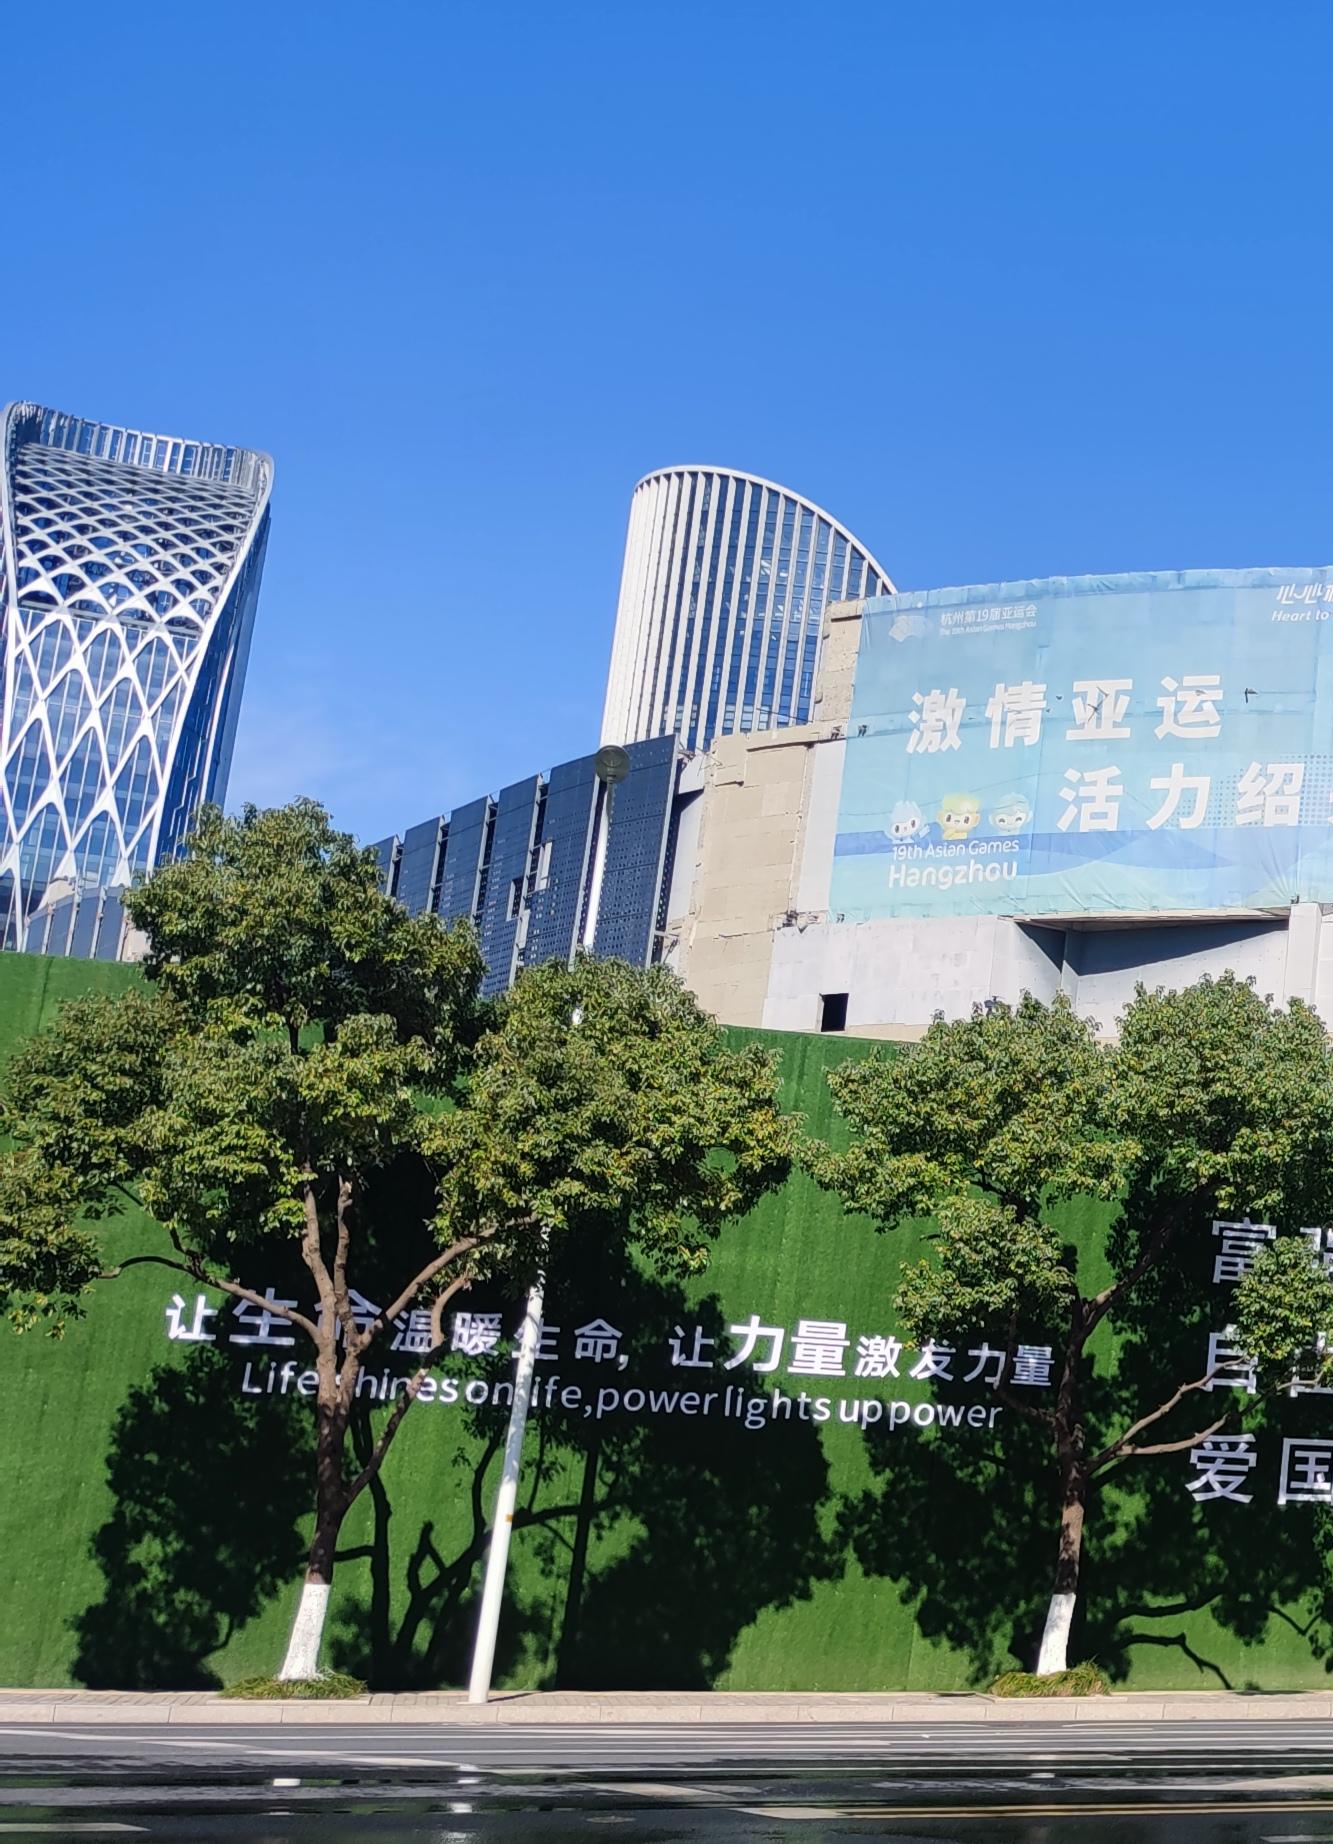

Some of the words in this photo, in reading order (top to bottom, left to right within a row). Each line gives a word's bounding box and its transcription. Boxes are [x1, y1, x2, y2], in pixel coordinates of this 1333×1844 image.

[940, 604, 1038, 626] 杭州第19届亚运会
[1271, 610, 1311, 623] Heart
[1315, 609, 1329, 621] to
[905, 674, 1224, 754] 激情亚运
[892, 844, 922, 861] 19th
[924, 842, 966, 860] Asian
[968, 839, 1020, 856] Games
[888, 859, 1018, 890] Hangzhou
[241, 1361, 318, 1397] Life
[336, 1366, 459, 1404] hines
[596, 1386, 718, 1420] power
[724, 1385, 831, 1430] lights
[839, 1398, 883, 1430] up
[889, 1400, 1004, 1432] power
